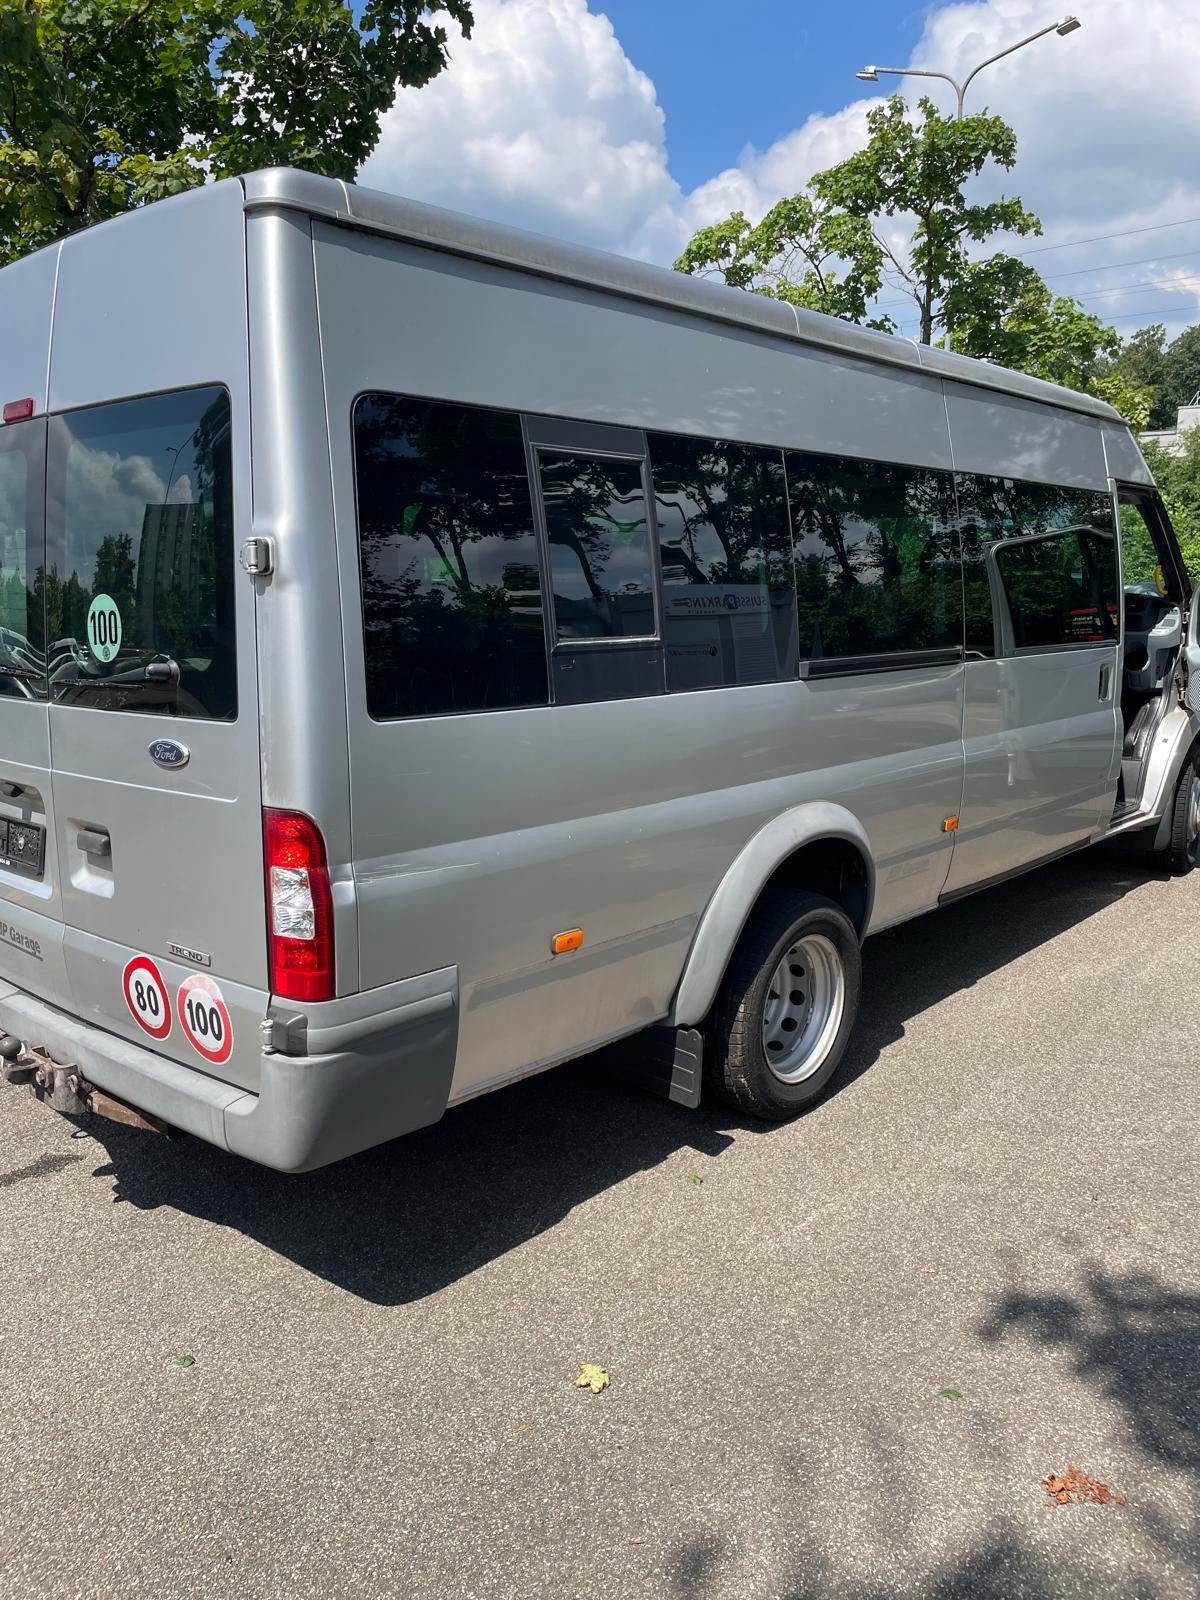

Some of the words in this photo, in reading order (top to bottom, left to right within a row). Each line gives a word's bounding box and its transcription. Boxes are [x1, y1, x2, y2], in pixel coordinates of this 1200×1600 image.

[90, 610, 117, 646] 100
[154, 744, 177, 761] Ford
[10, 926, 41, 956] Garage
[170, 944, 203, 962] TREND
[135, 980, 159, 1017] 80
[187, 998, 223, 1042] 100
